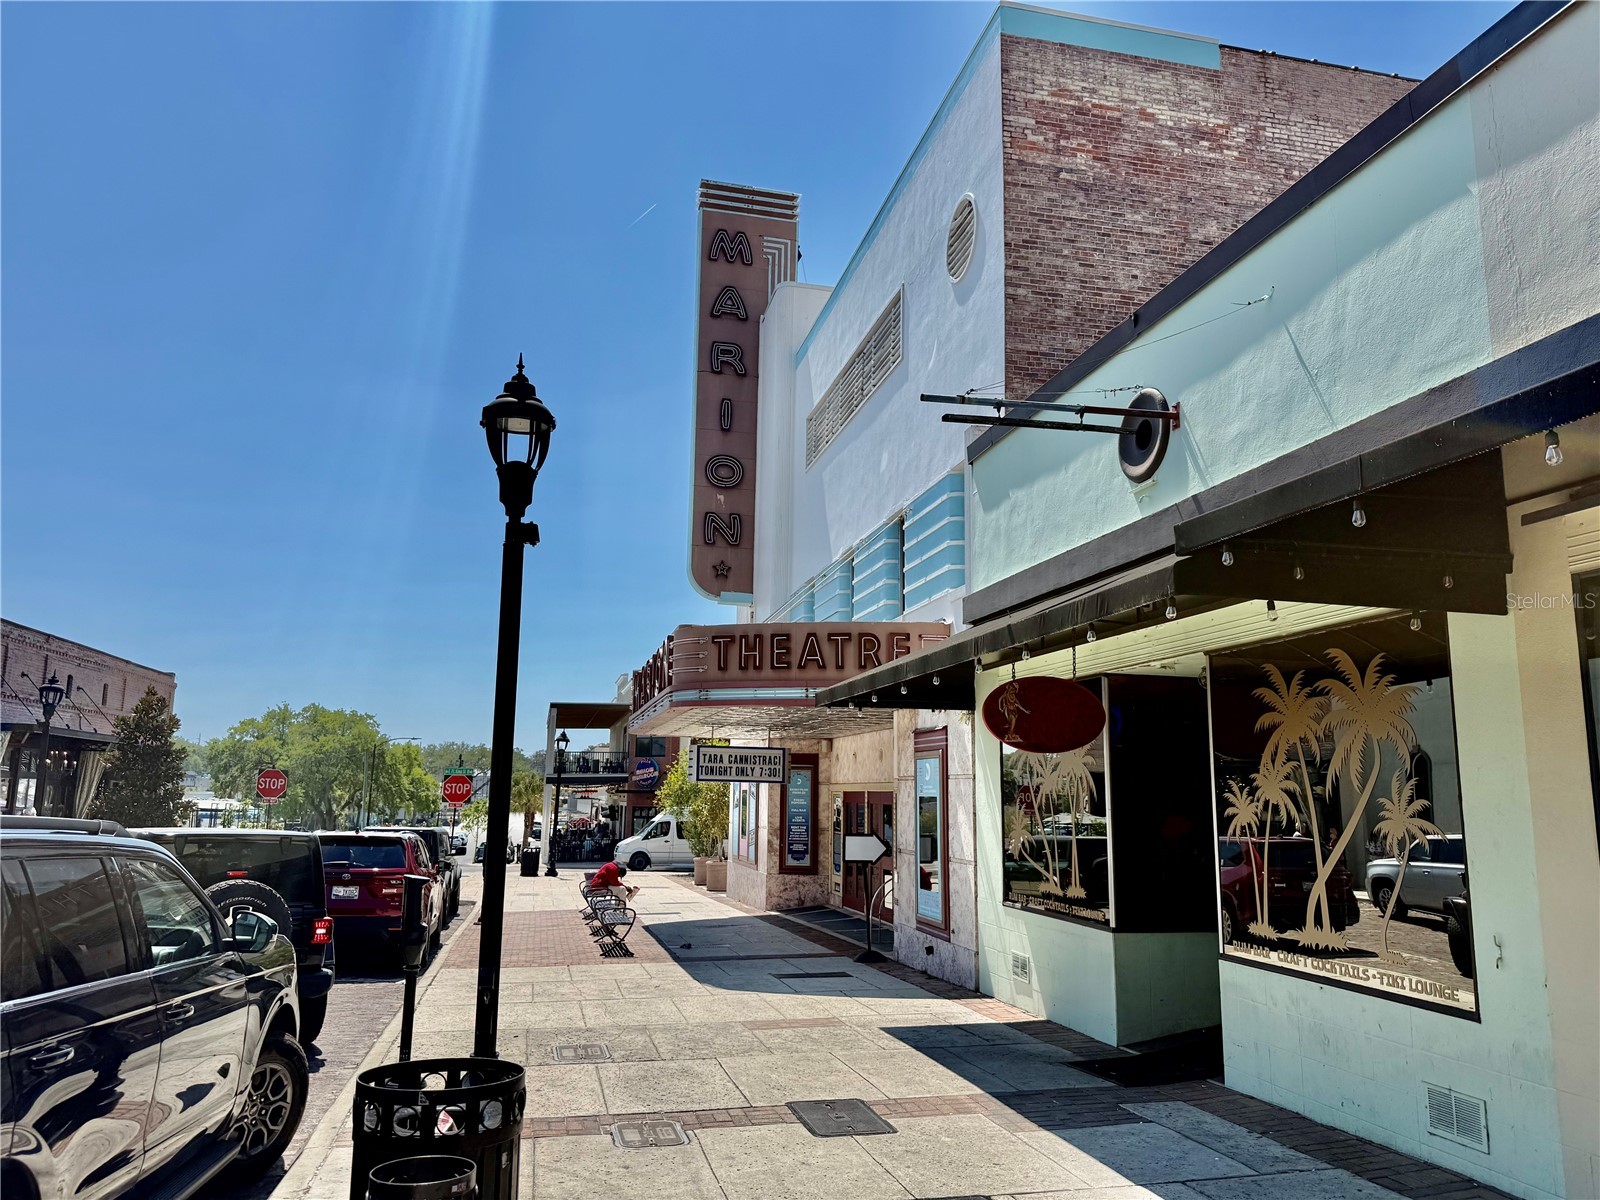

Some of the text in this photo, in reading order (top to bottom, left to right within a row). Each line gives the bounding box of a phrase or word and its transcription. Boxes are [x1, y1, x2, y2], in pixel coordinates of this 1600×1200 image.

[705, 229, 753, 546] MARION
[712, 632, 911, 671] THEATRE
[702, 754, 781, 766] TARA CANNISTRACI
[700, 765, 781, 778] TONIGHT ONLY 7:30!
[258, 778, 285, 789] STOP
[445, 783, 470, 794] STOP
[1043, 899, 1070, 913] COCKTAILS
[1232, 940, 1460, 1002] RUM BAR CRAFT COCKTAILS TIKI LOUNGE
